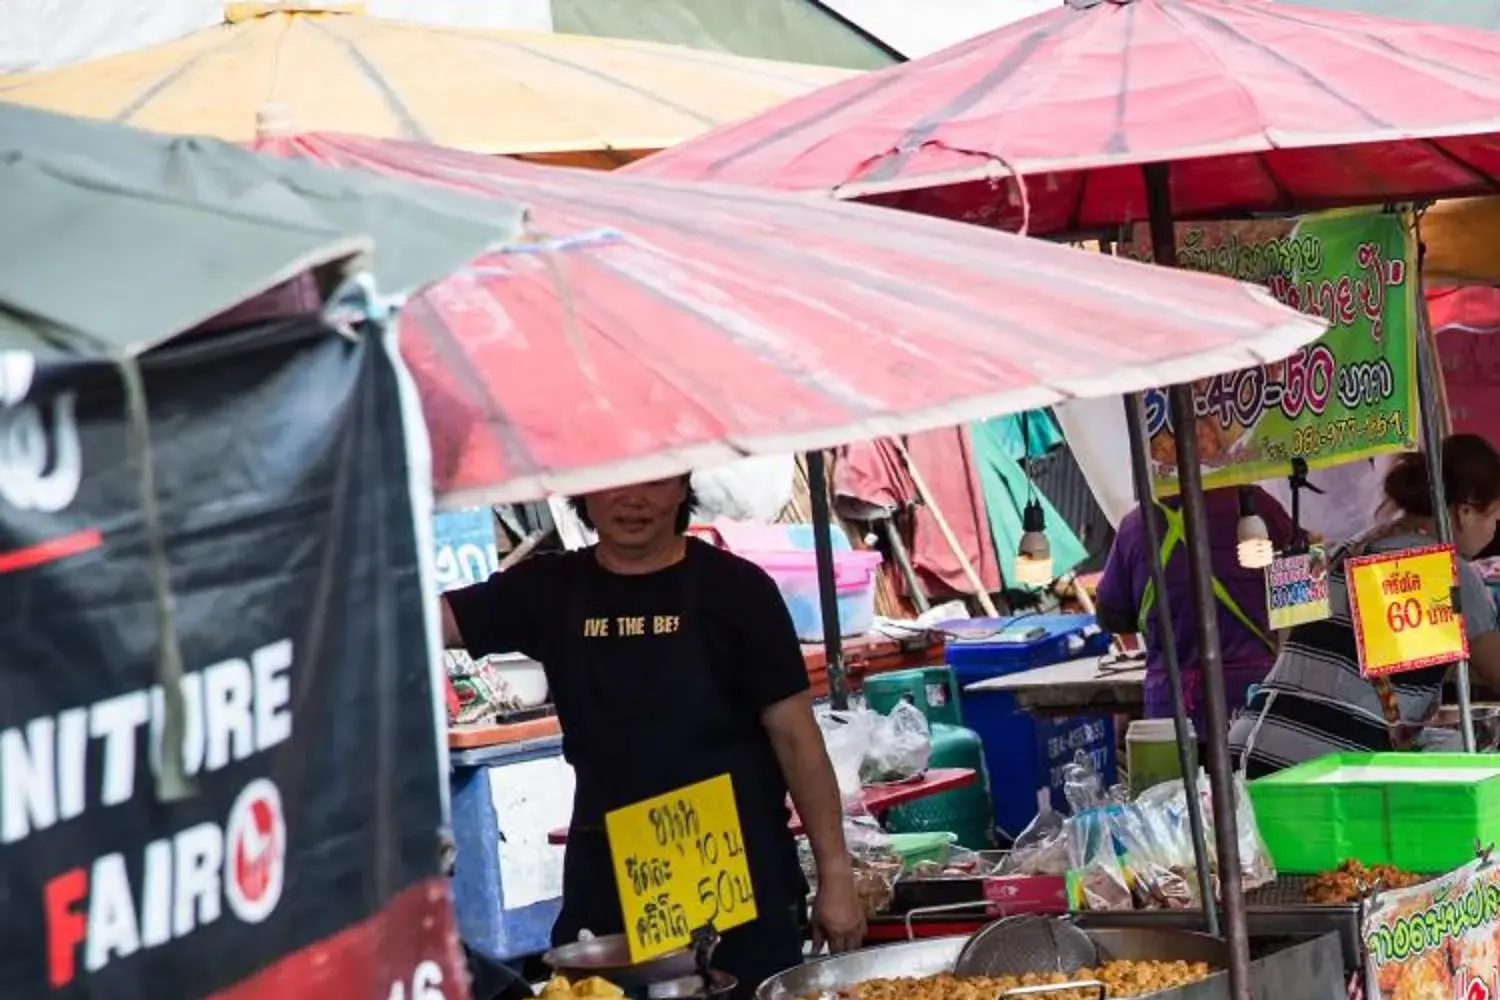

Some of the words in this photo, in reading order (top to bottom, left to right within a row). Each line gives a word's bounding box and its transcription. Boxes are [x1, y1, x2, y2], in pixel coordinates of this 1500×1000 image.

[616, 616, 646, 637] THE
[1387, 597, 1422, 632] 60
[695, 831, 719, 868] 10
[43, 822, 224, 990] FAIR
